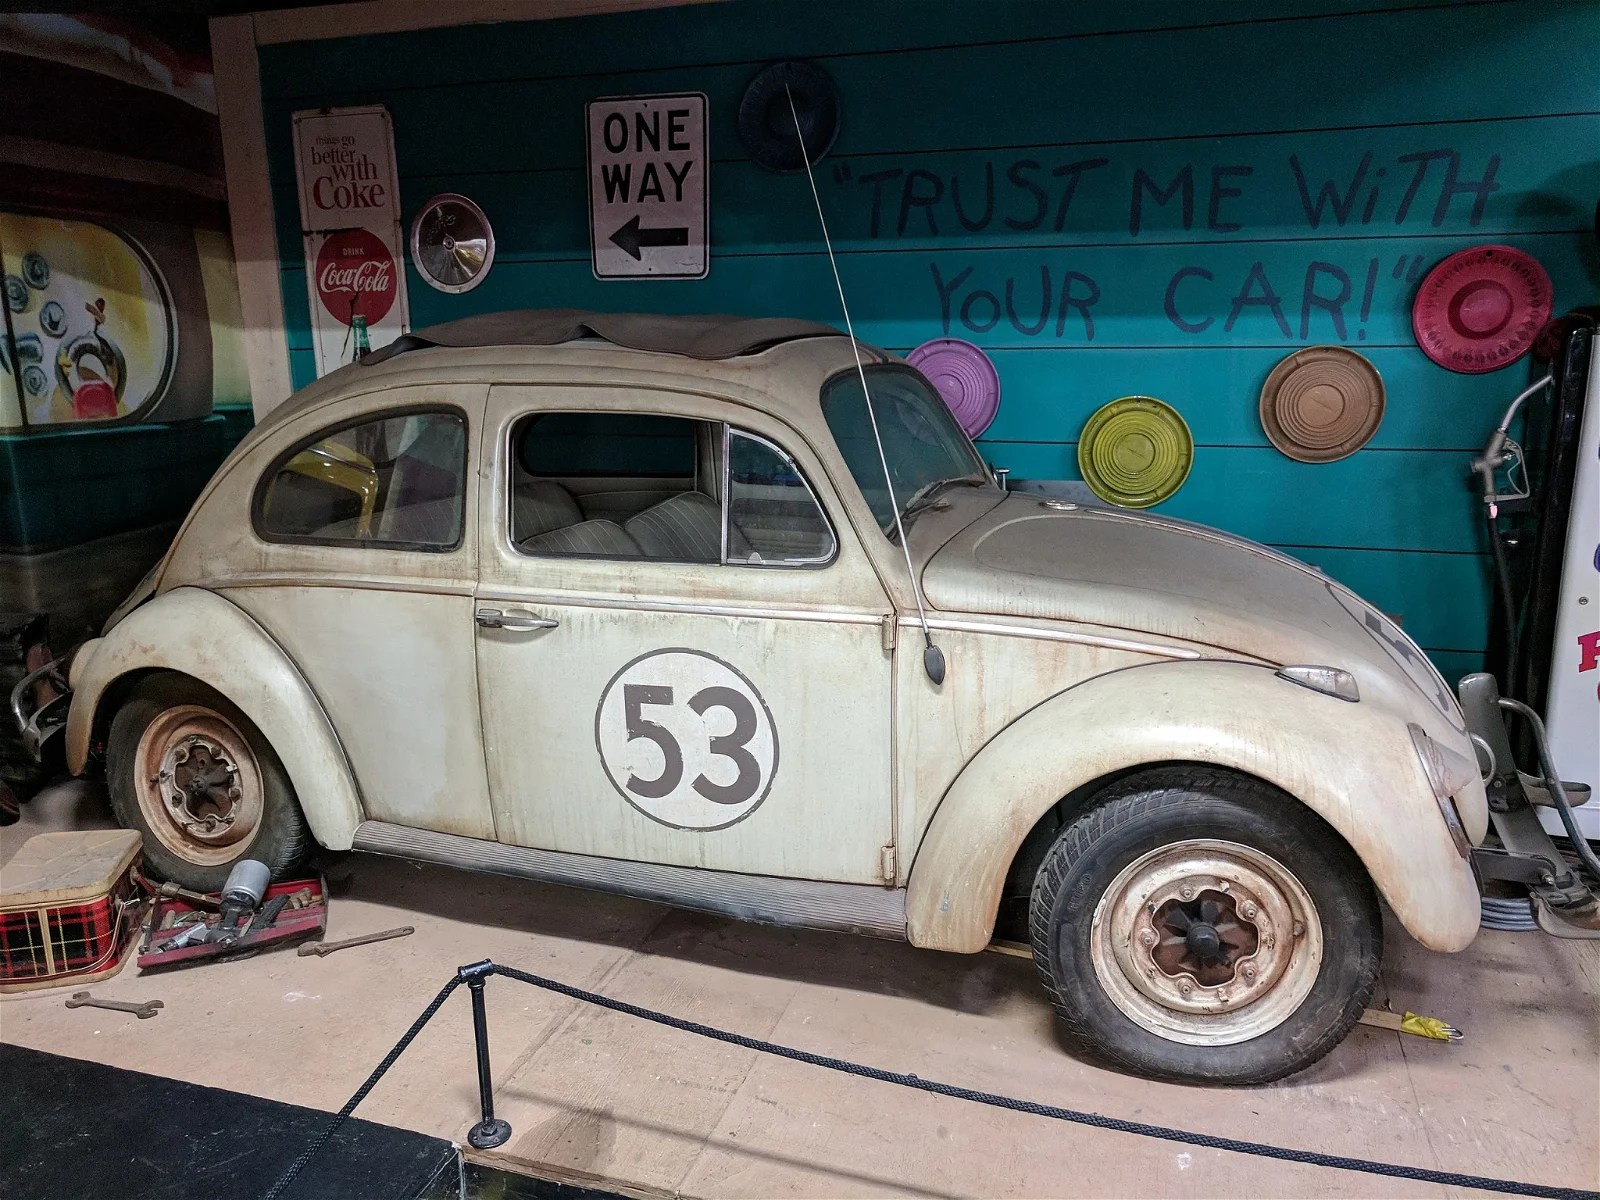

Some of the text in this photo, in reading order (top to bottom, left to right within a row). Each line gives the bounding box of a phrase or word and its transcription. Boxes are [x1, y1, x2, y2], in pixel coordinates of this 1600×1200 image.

[341, 135, 356, 150] go
[603, 109, 691, 154] ONE
[311, 146, 356, 166] better
[331, 154, 378, 181] with
[313, 176, 386, 211] Coke
[601, 160, 694, 204] WAY
[1128, 162, 1254, 238] ME
[342, 247, 365, 256] DRINK
[623, 683, 762, 805] 53
